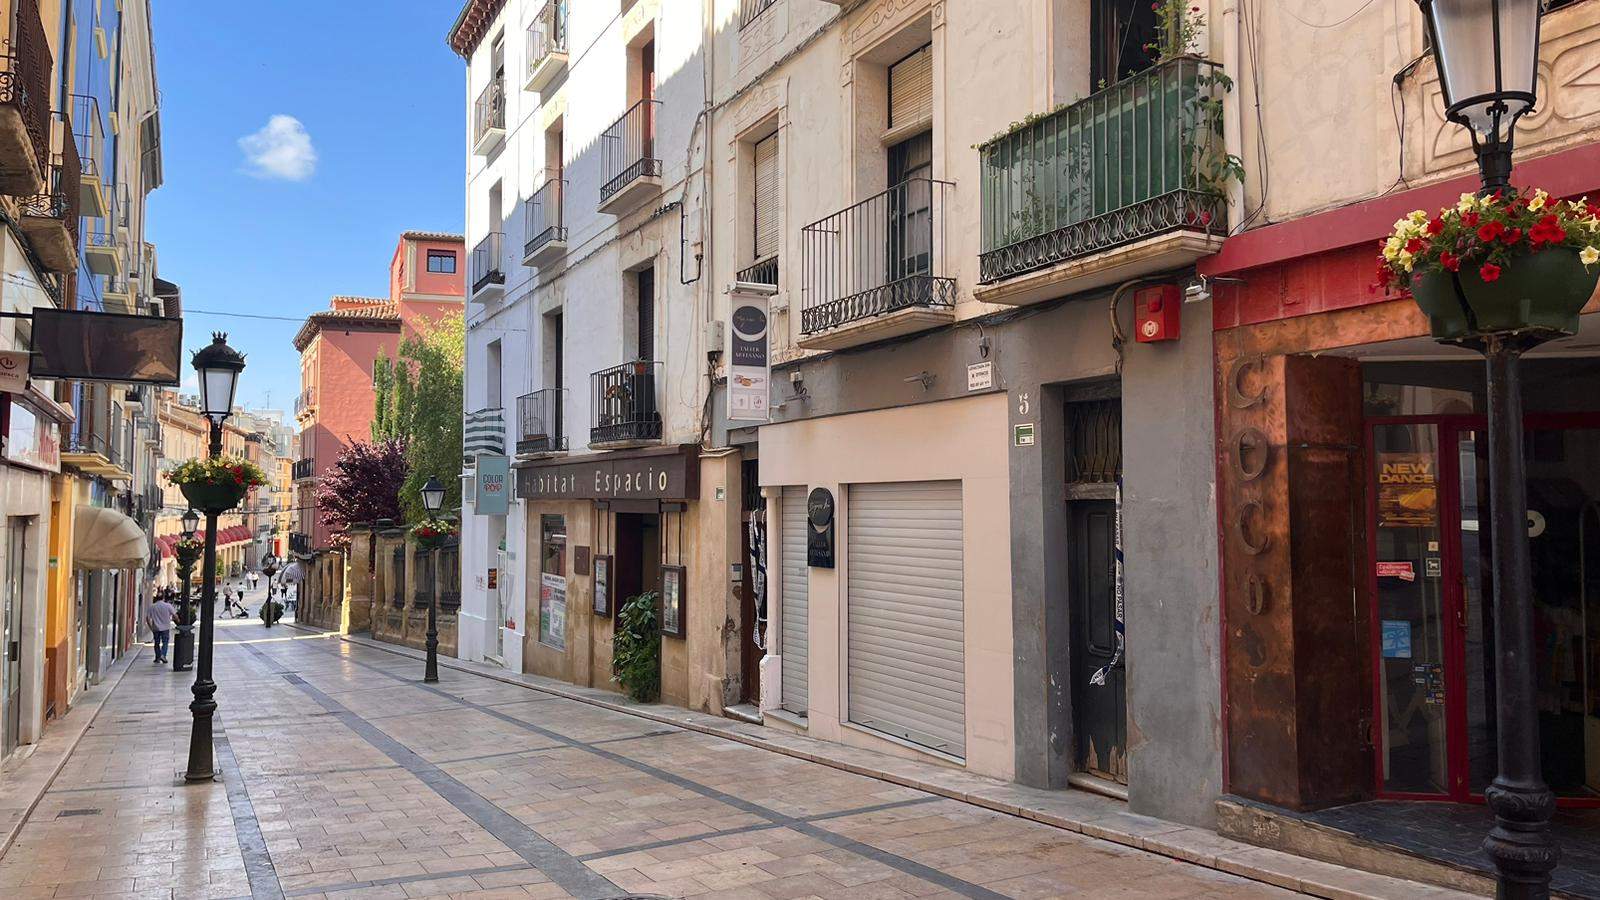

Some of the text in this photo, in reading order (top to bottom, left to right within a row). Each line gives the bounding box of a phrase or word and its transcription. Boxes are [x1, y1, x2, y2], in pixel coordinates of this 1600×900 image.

[1383, 463, 1431, 474] NEW
[482, 474, 504, 483] COLOR
[594, 467, 667, 496] Espacio
[1379, 474, 1434, 484] DANCE
